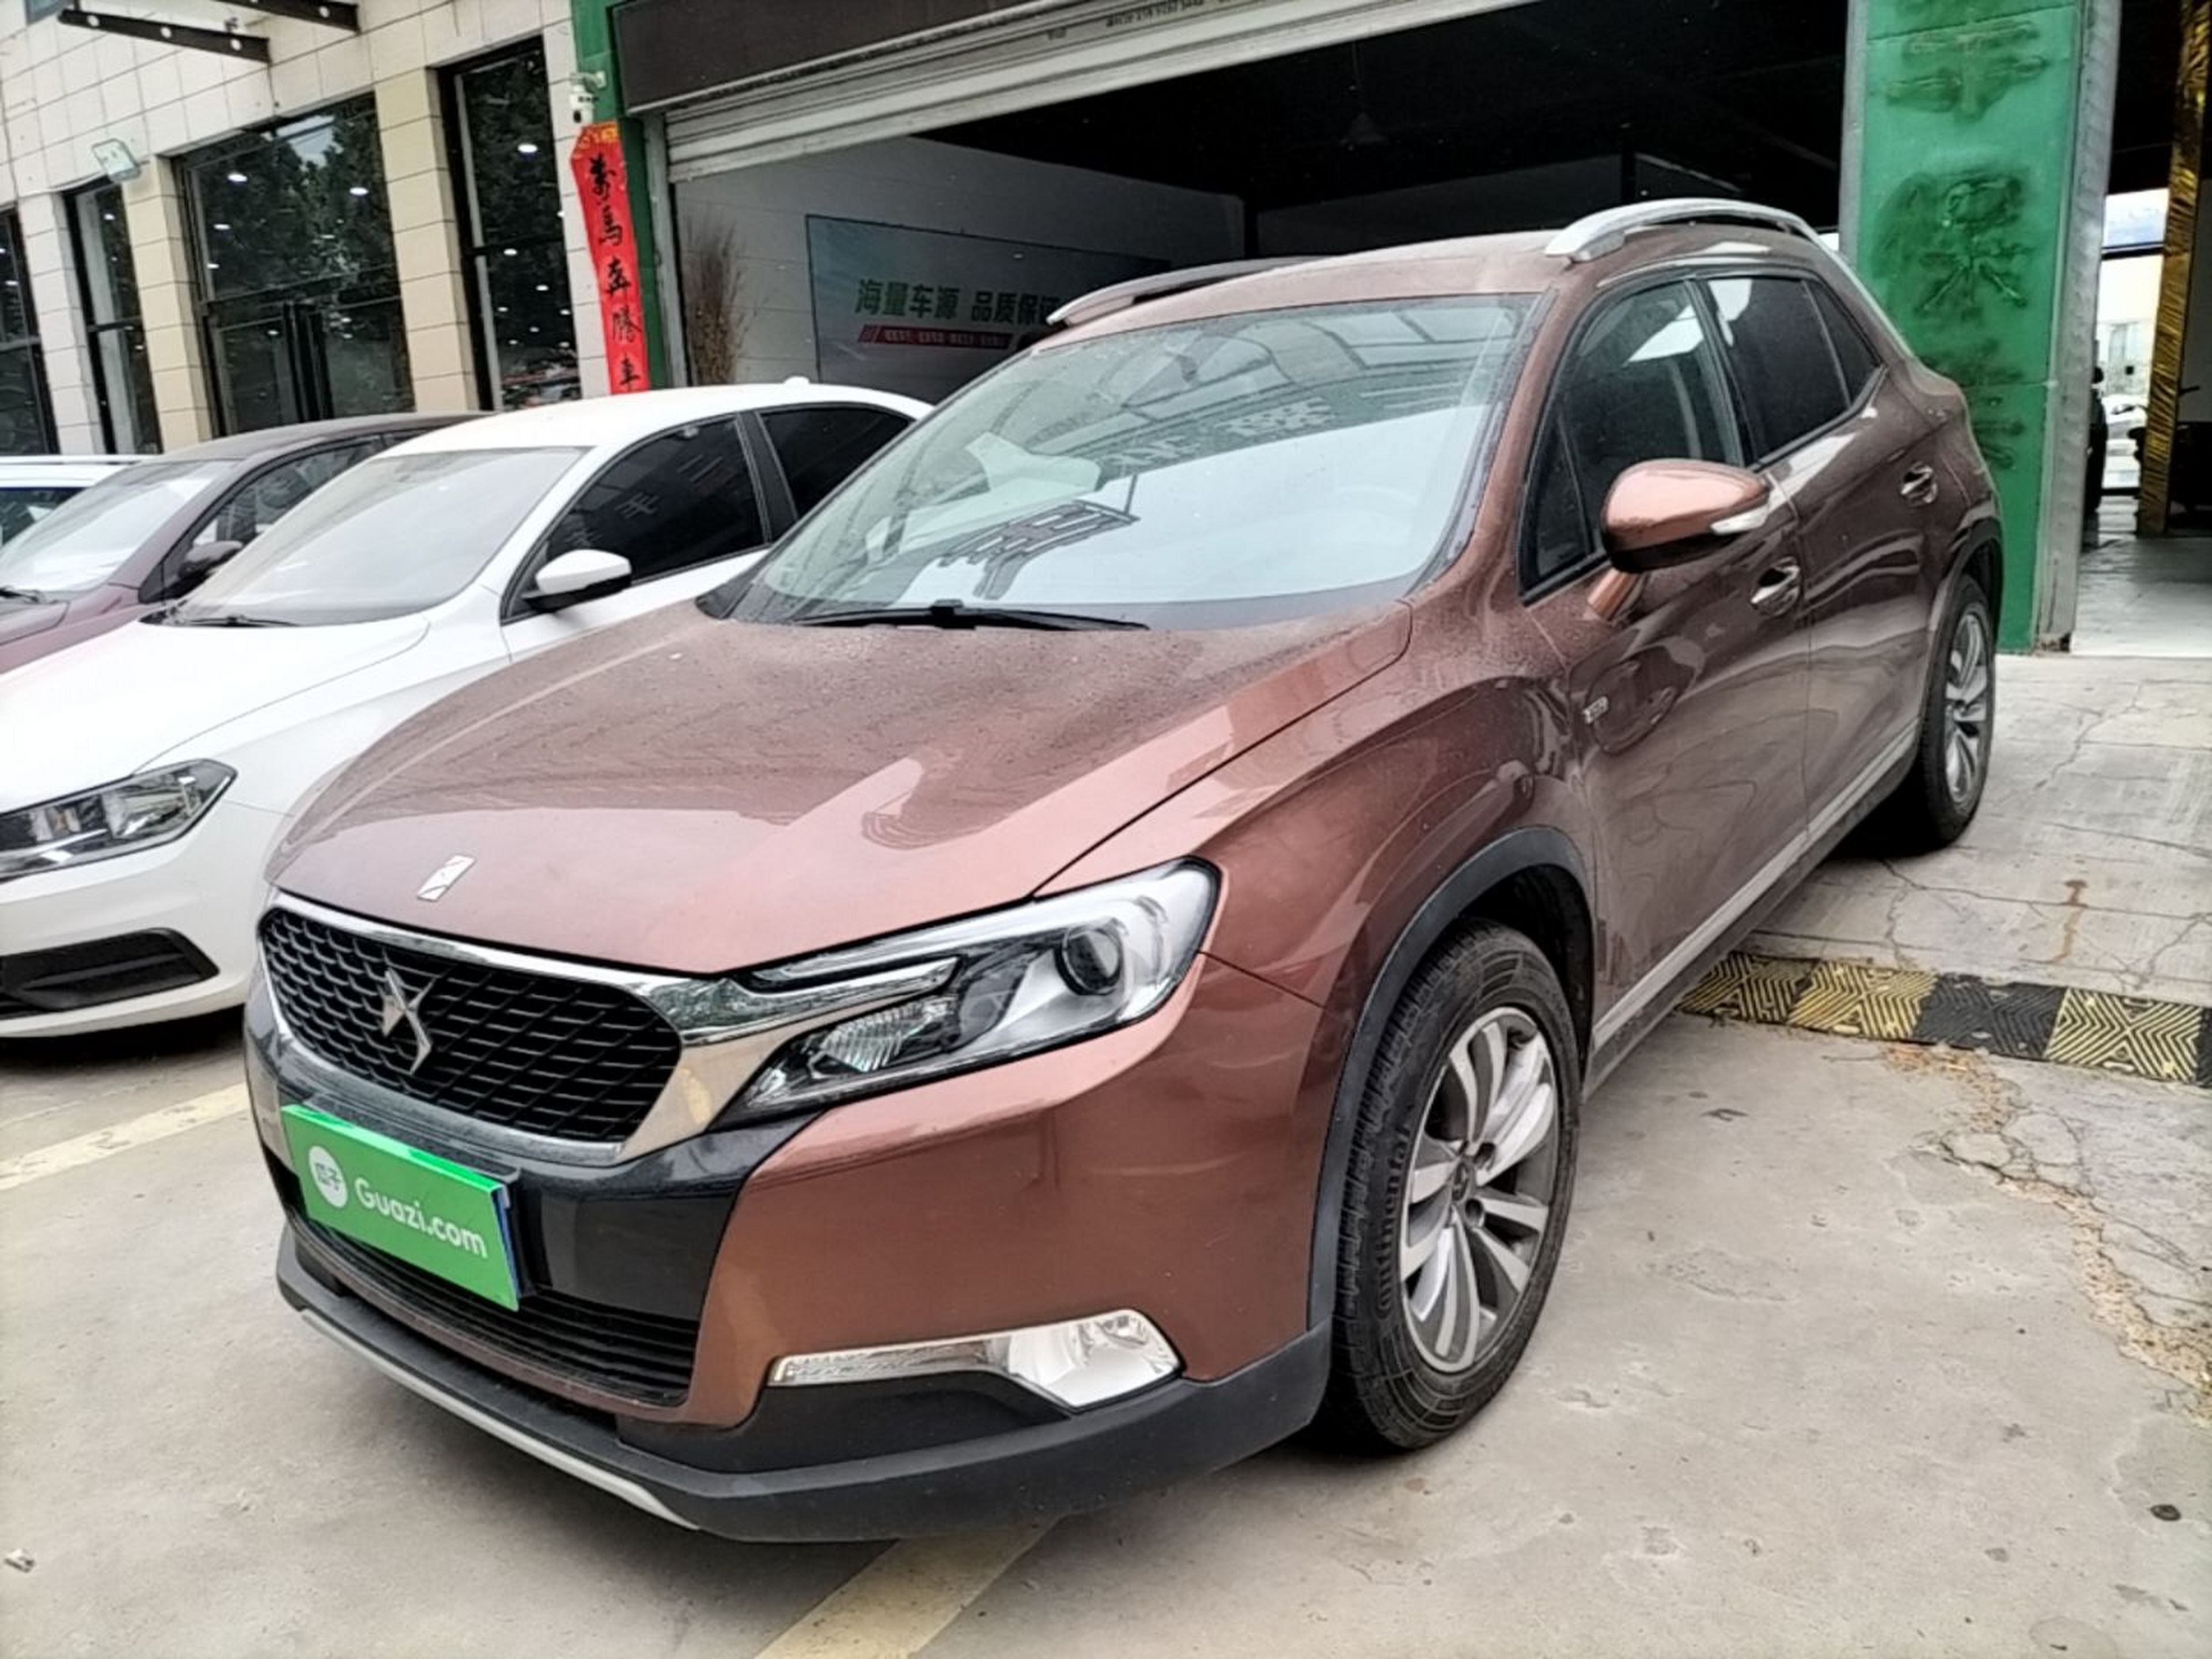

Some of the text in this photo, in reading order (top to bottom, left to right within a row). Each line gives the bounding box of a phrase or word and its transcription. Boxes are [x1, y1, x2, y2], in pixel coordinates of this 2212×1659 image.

[855, 278, 960, 320] 海量车源
[354, 1177, 488, 1260] Guazi.com
[1375, 1124, 1411, 1320] Continental
